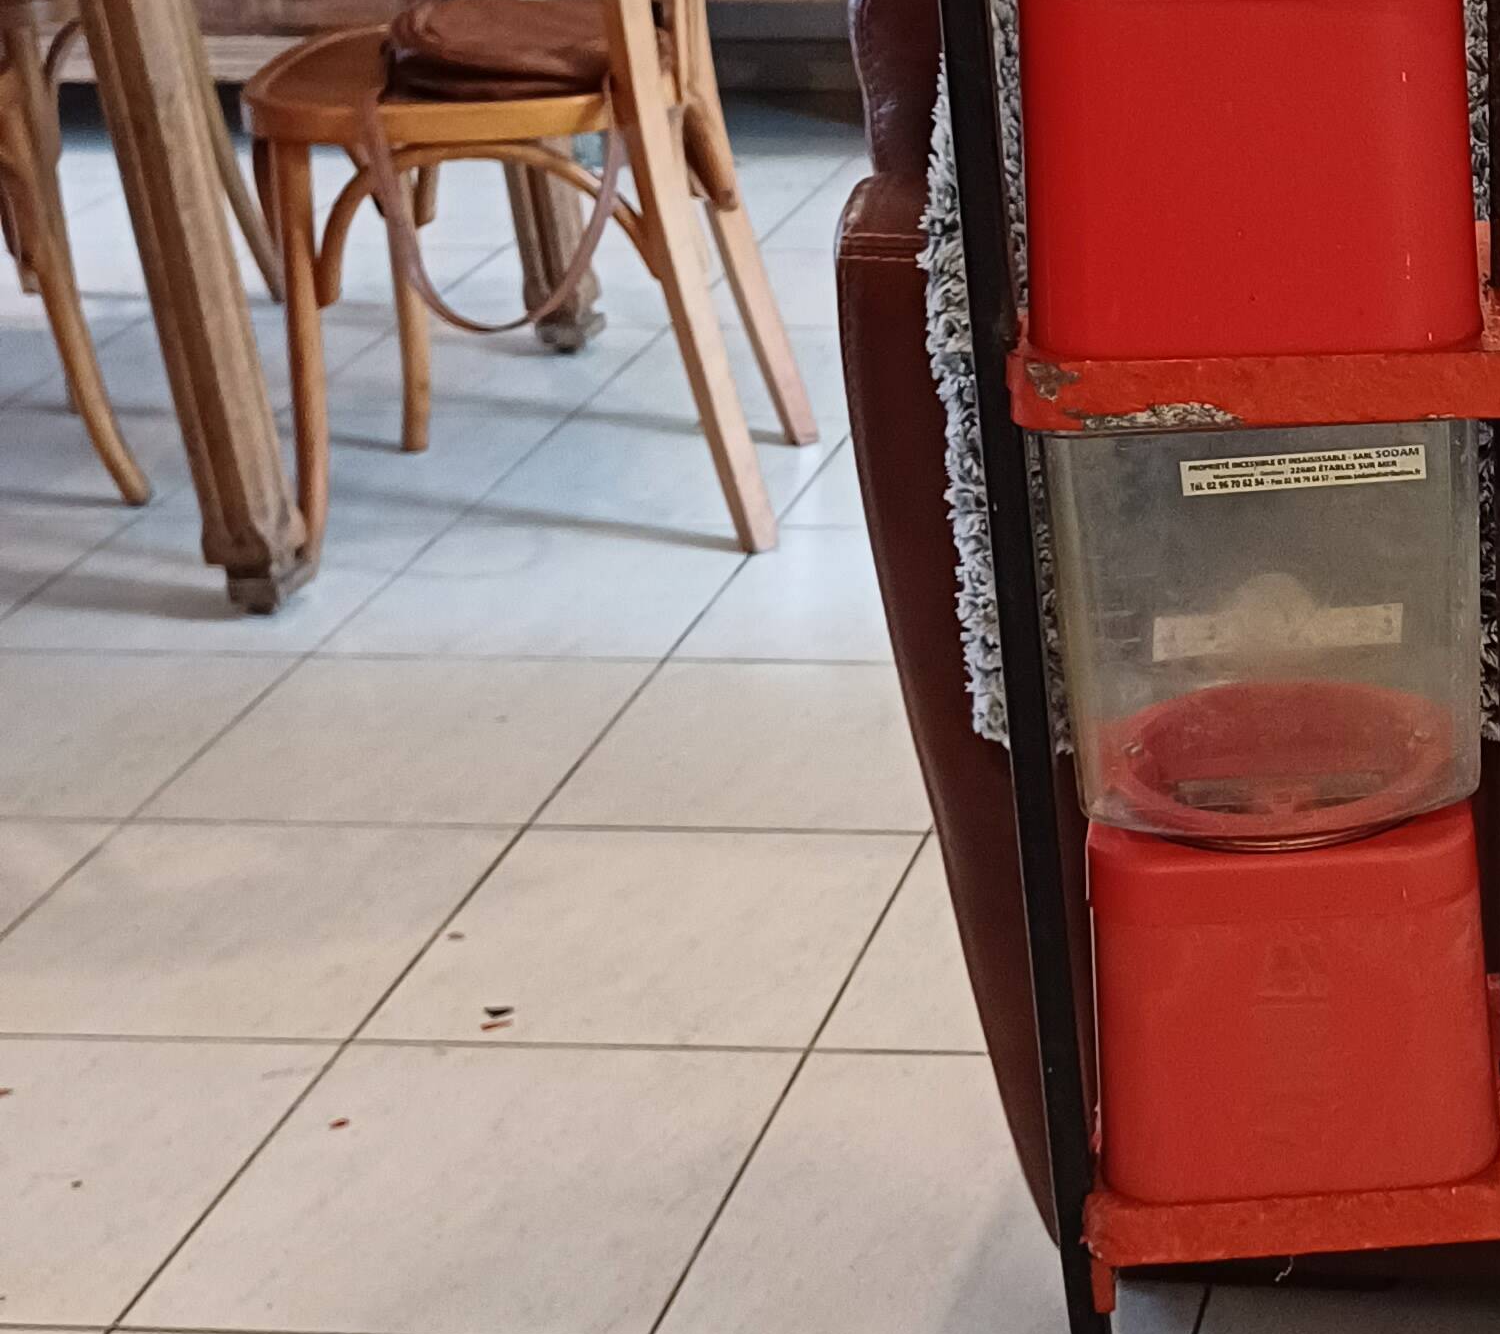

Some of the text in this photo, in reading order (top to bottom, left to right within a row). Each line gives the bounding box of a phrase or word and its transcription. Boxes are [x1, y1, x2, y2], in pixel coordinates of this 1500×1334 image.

[1353, 452, 1372, 460] SARL
[1376, 448, 1419, 458] SODAM
[1319, 462, 1355, 472] ÉTABLES
[1231, 480, 1241, 488] 70
